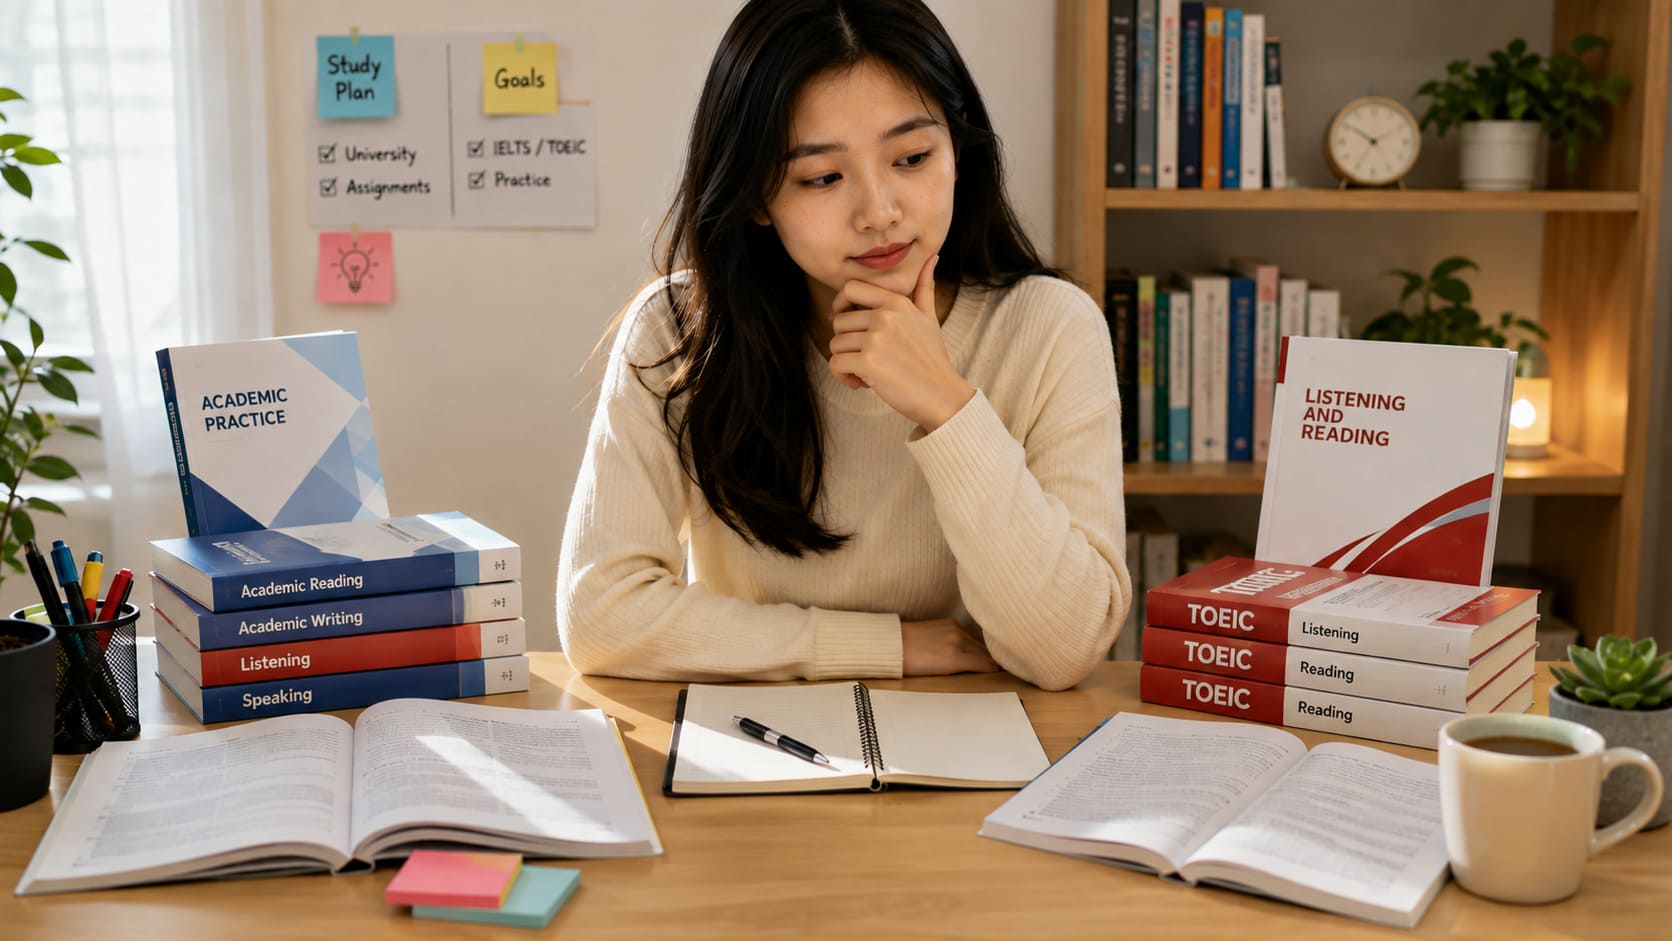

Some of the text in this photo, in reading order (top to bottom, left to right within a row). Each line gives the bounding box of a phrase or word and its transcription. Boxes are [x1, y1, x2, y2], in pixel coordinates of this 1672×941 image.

[327, 53, 382, 80] Study
[494, 67, 545, 90] Goals
[335, 80, 376, 102] Plan
[345, 145, 417, 167] University
[494, 139, 532, 156] IELTS
[547, 138, 587, 155] TOEIC
[346, 179, 431, 201] Assignments
[495, 171, 552, 188] Practice
[201, 388, 288, 411] ACADEMIC
[1304, 387, 1406, 412] LISTENING
[204, 409, 286, 432] PRACTICE
[1302, 406, 1344, 424] AND
[1300, 423, 1390, 447] READING
[240, 574, 364, 599] Academic Reading
[238, 611, 364, 636] Academic Writing
[1187, 603, 1360, 644] TOEIC Listening
[240, 653, 312, 672] Listening
[1184, 640, 1354, 684] TOEIC Reading
[242, 688, 313, 710] Speaking
[1182, 679, 1353, 724] TOEIC Reading
